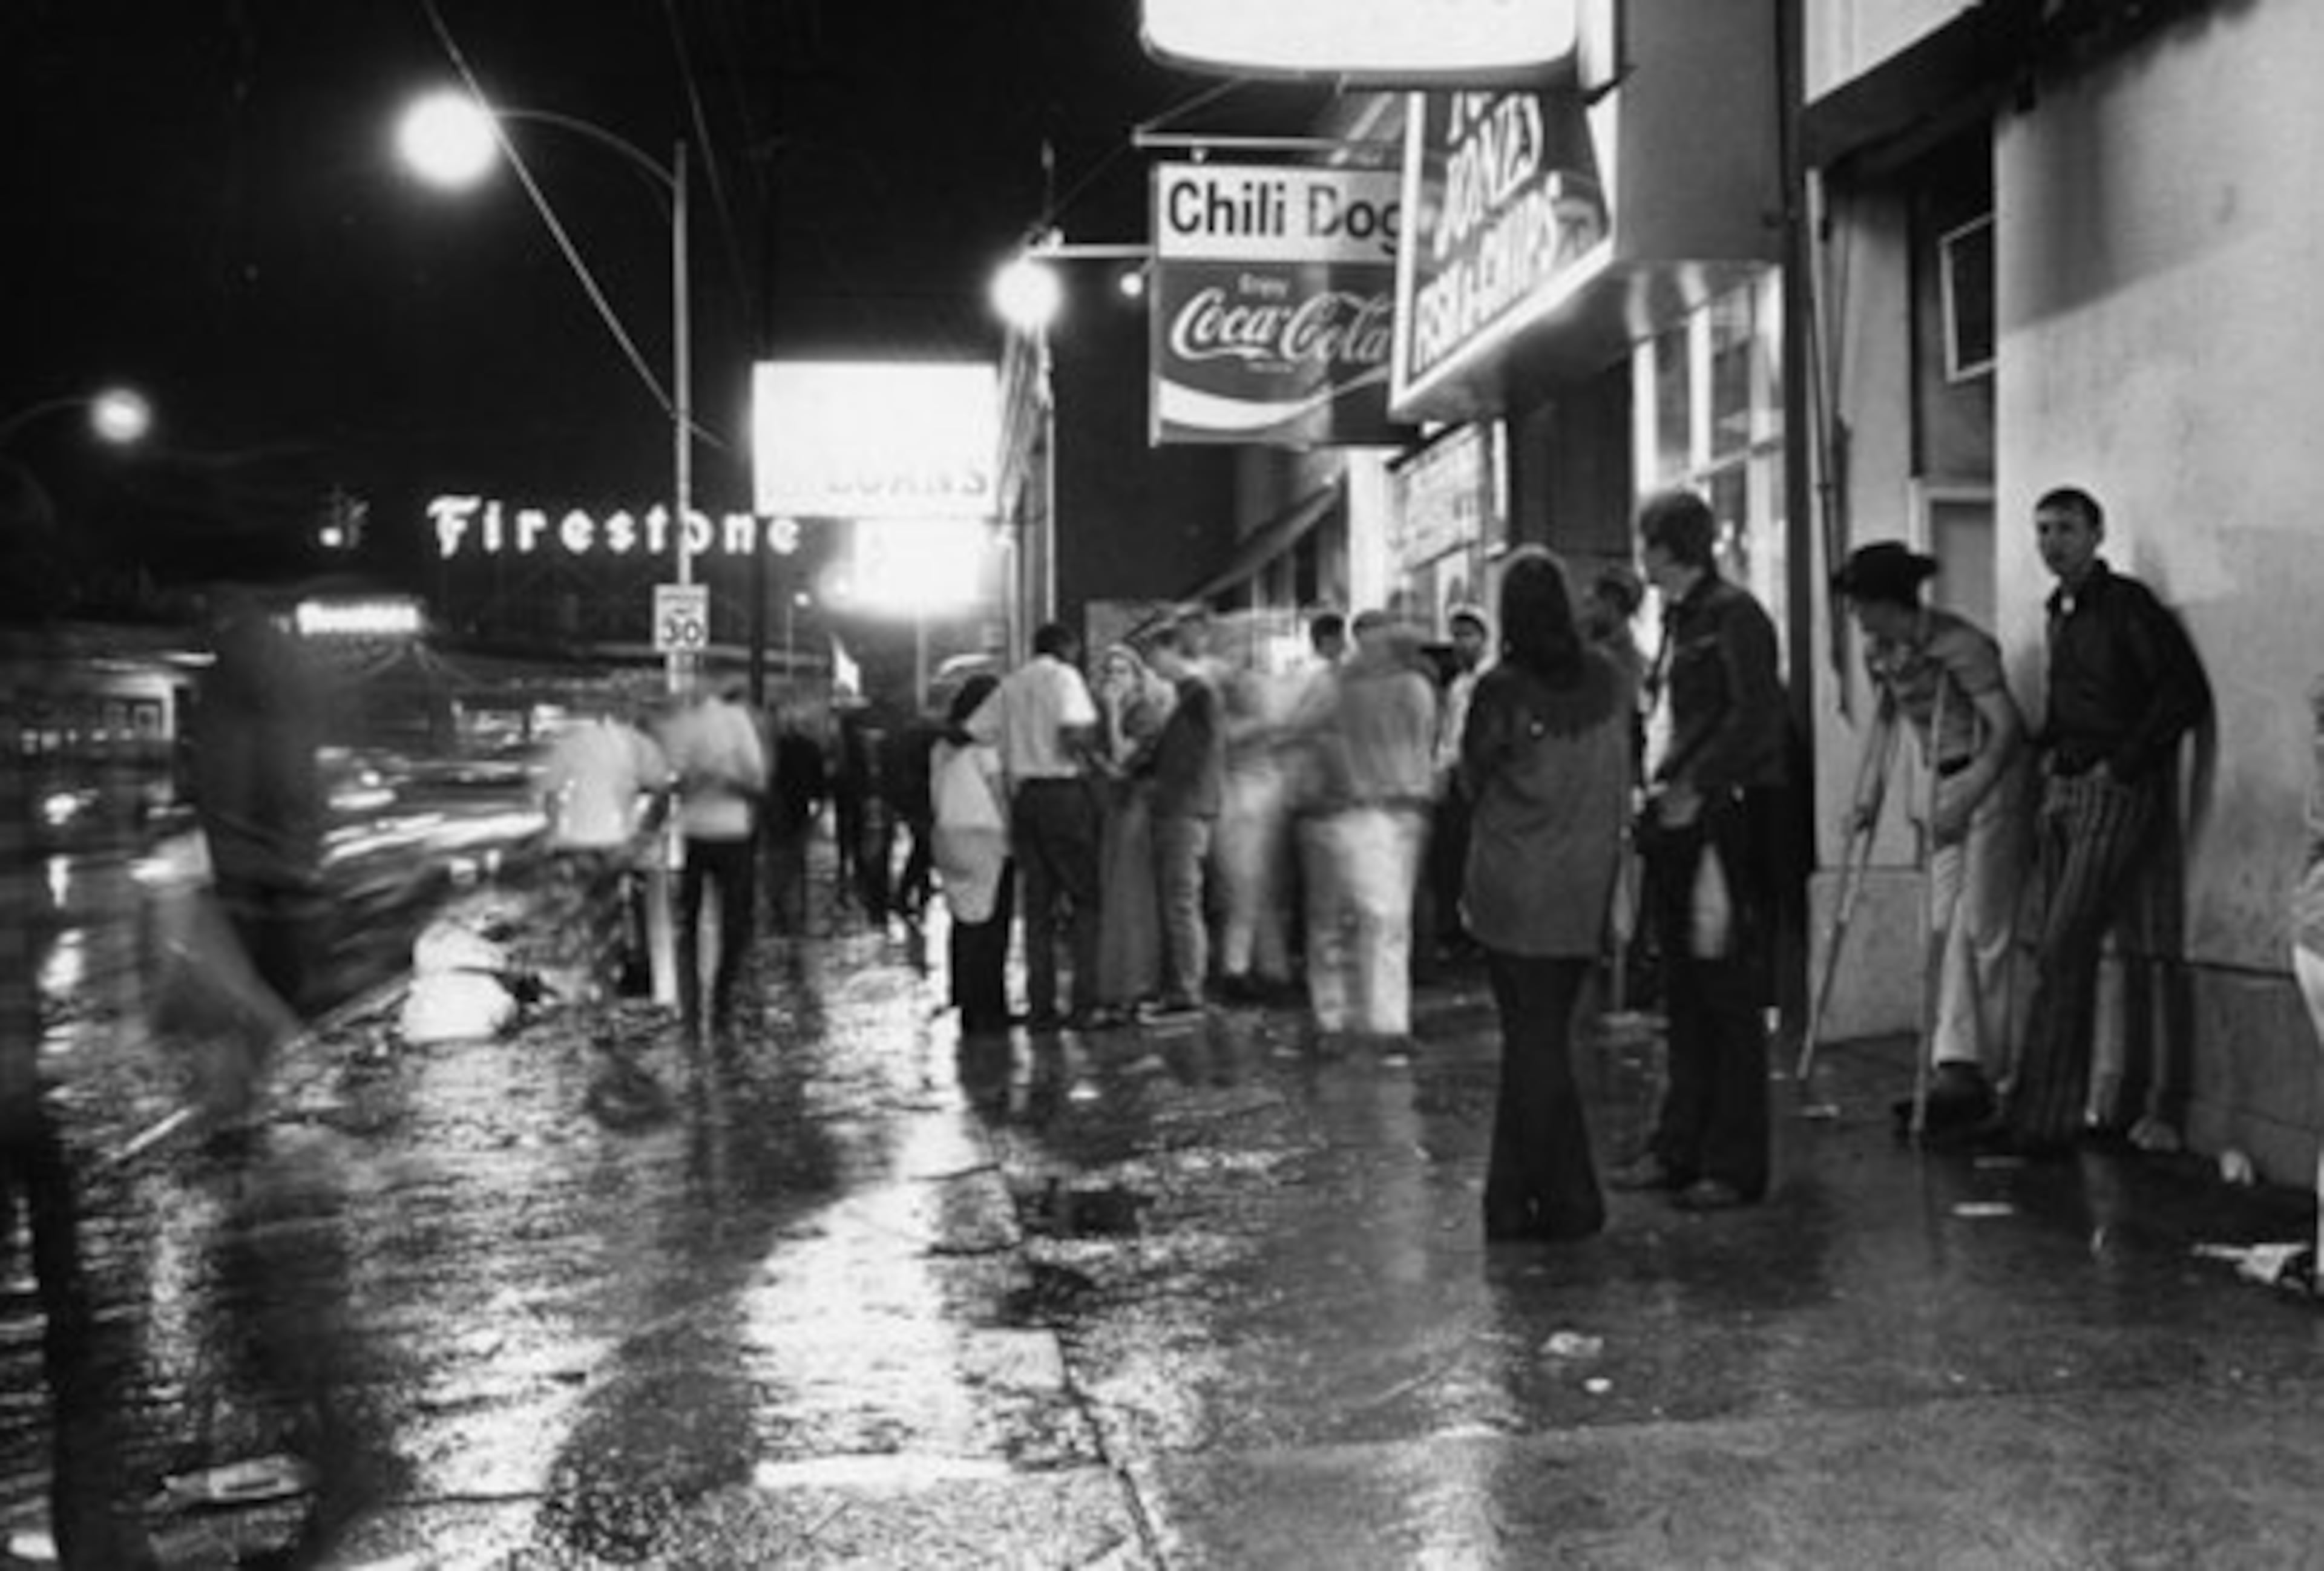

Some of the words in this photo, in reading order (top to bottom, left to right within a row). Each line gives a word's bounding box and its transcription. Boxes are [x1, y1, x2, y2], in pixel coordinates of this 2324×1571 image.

[1168, 180, 1285, 237] Chili
[426, 496, 802, 559] Firestone
[662, 616, 701, 646] 30
